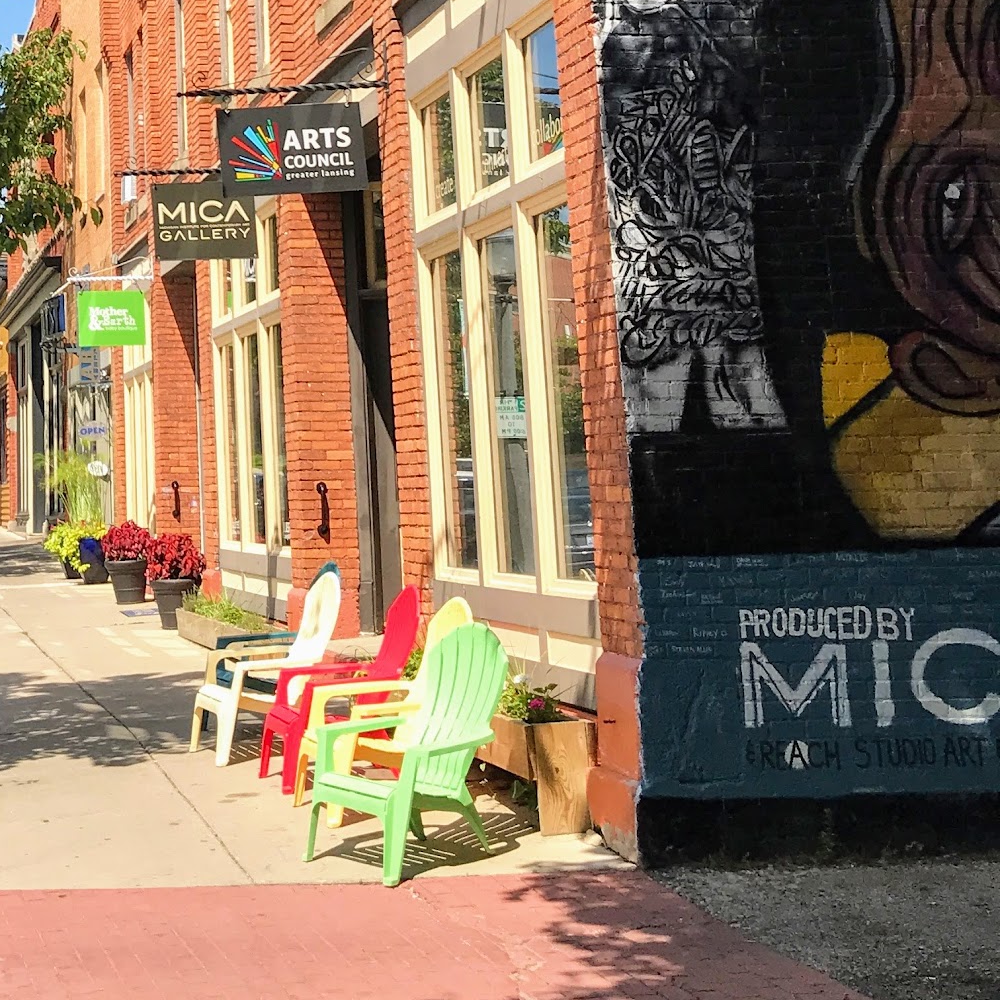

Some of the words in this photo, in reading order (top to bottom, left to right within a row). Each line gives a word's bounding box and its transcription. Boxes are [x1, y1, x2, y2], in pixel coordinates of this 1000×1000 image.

[283, 126, 352, 151] ARTS
[284, 153, 354, 170] COUNCIL
[285, 171, 318, 181] greater
[320, 168, 355, 179] lansing
[157, 199, 251, 225] MICA
[159, 227, 251, 242] GALLERY
[88, 306, 128, 317] Mother
[80, 427, 105, 436] OPEN
[739, 605, 873, 640] PRODUCED
[875, 607, 915, 641] BY
[760, 738, 841, 770] REACH
[853, 737, 936, 769] STUDIO
[943, 737, 987, 769] ART
